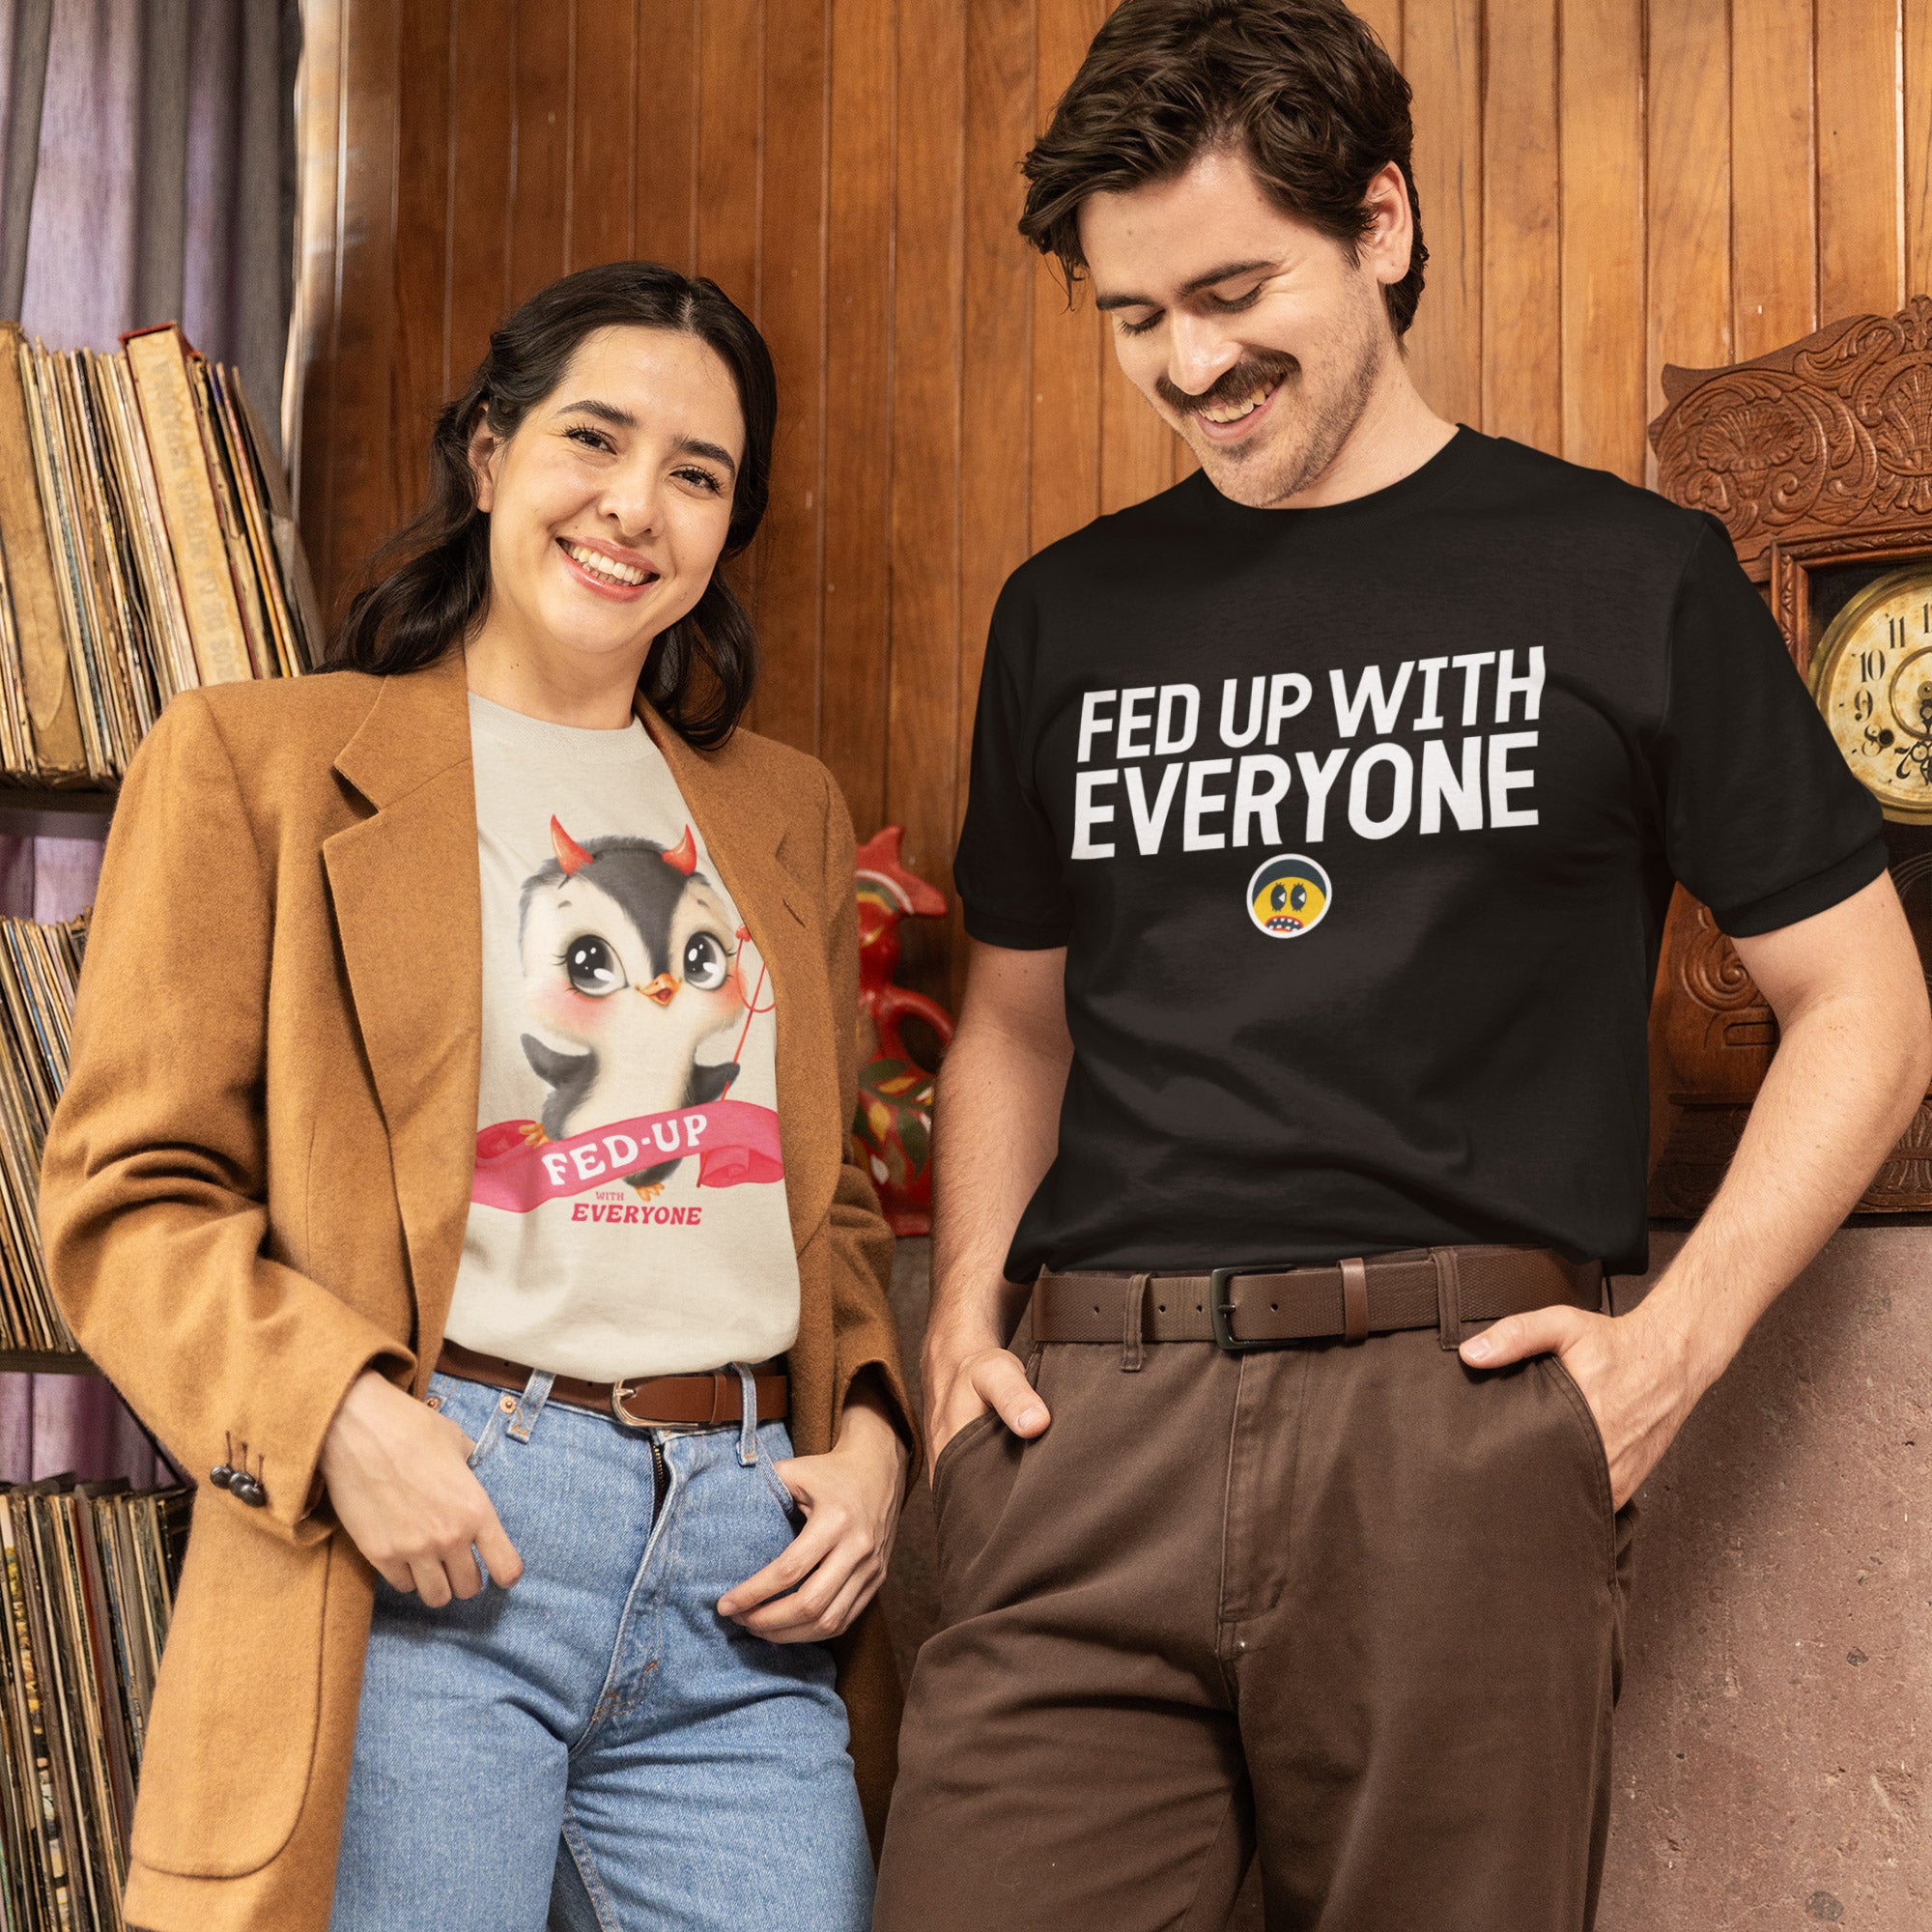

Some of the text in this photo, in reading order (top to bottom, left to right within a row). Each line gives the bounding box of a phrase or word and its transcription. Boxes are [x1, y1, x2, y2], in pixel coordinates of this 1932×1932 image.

[1889, 615, 1906, 649] 11
[1923, 603, 1932, 634] 1
[1860, 648, 1885, 683] 10
[1077, 645, 1546, 763] FED UP WITH
[1854, 689, 1873, 722] 9
[1861, 724, 1885, 757] 8
[1894, 745, 1914, 780] 7
[1070, 730, 1539, 860] EVERYONE
[541, 1114, 708, 1186] FED-UP
[595, 1191, 625, 1202] WITH
[571, 1202, 703, 1226] EVERYONE
